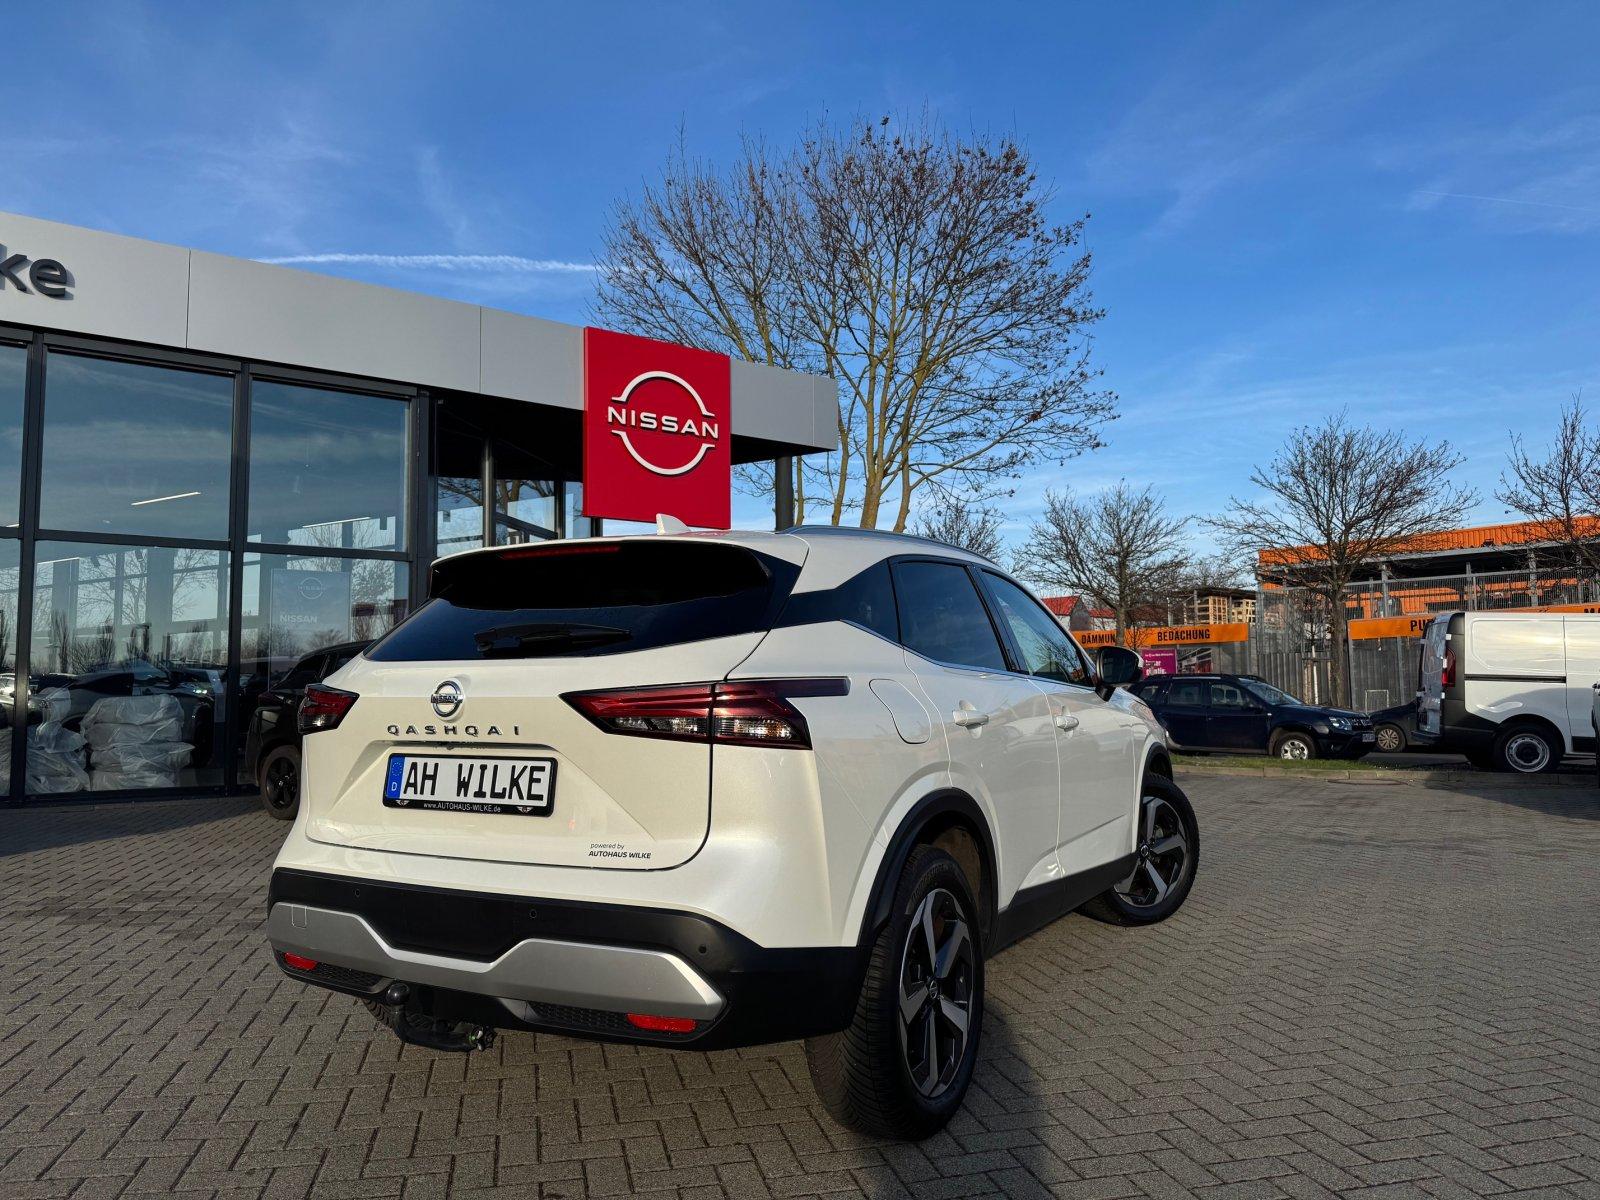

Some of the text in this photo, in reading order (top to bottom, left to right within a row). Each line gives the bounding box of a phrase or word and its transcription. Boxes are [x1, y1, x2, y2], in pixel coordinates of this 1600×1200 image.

[607, 405, 719, 439] NISSAN
[280, 614, 318, 623] NISSAN
[1081, 632, 1116, 644] DÄMMUN
[1157, 629, 1210, 641] BEDACHUNG
[431, 694, 460, 703] NISSAN
[387, 724, 520, 737] QASHQAI
[391, 781, 398, 792] D
[403, 761, 546, 801] AH WILKE
[423, 802, 501, 812] www.AUTOHAUS-WILKE.de
[588, 850, 628, 858] AUTOHAUS
